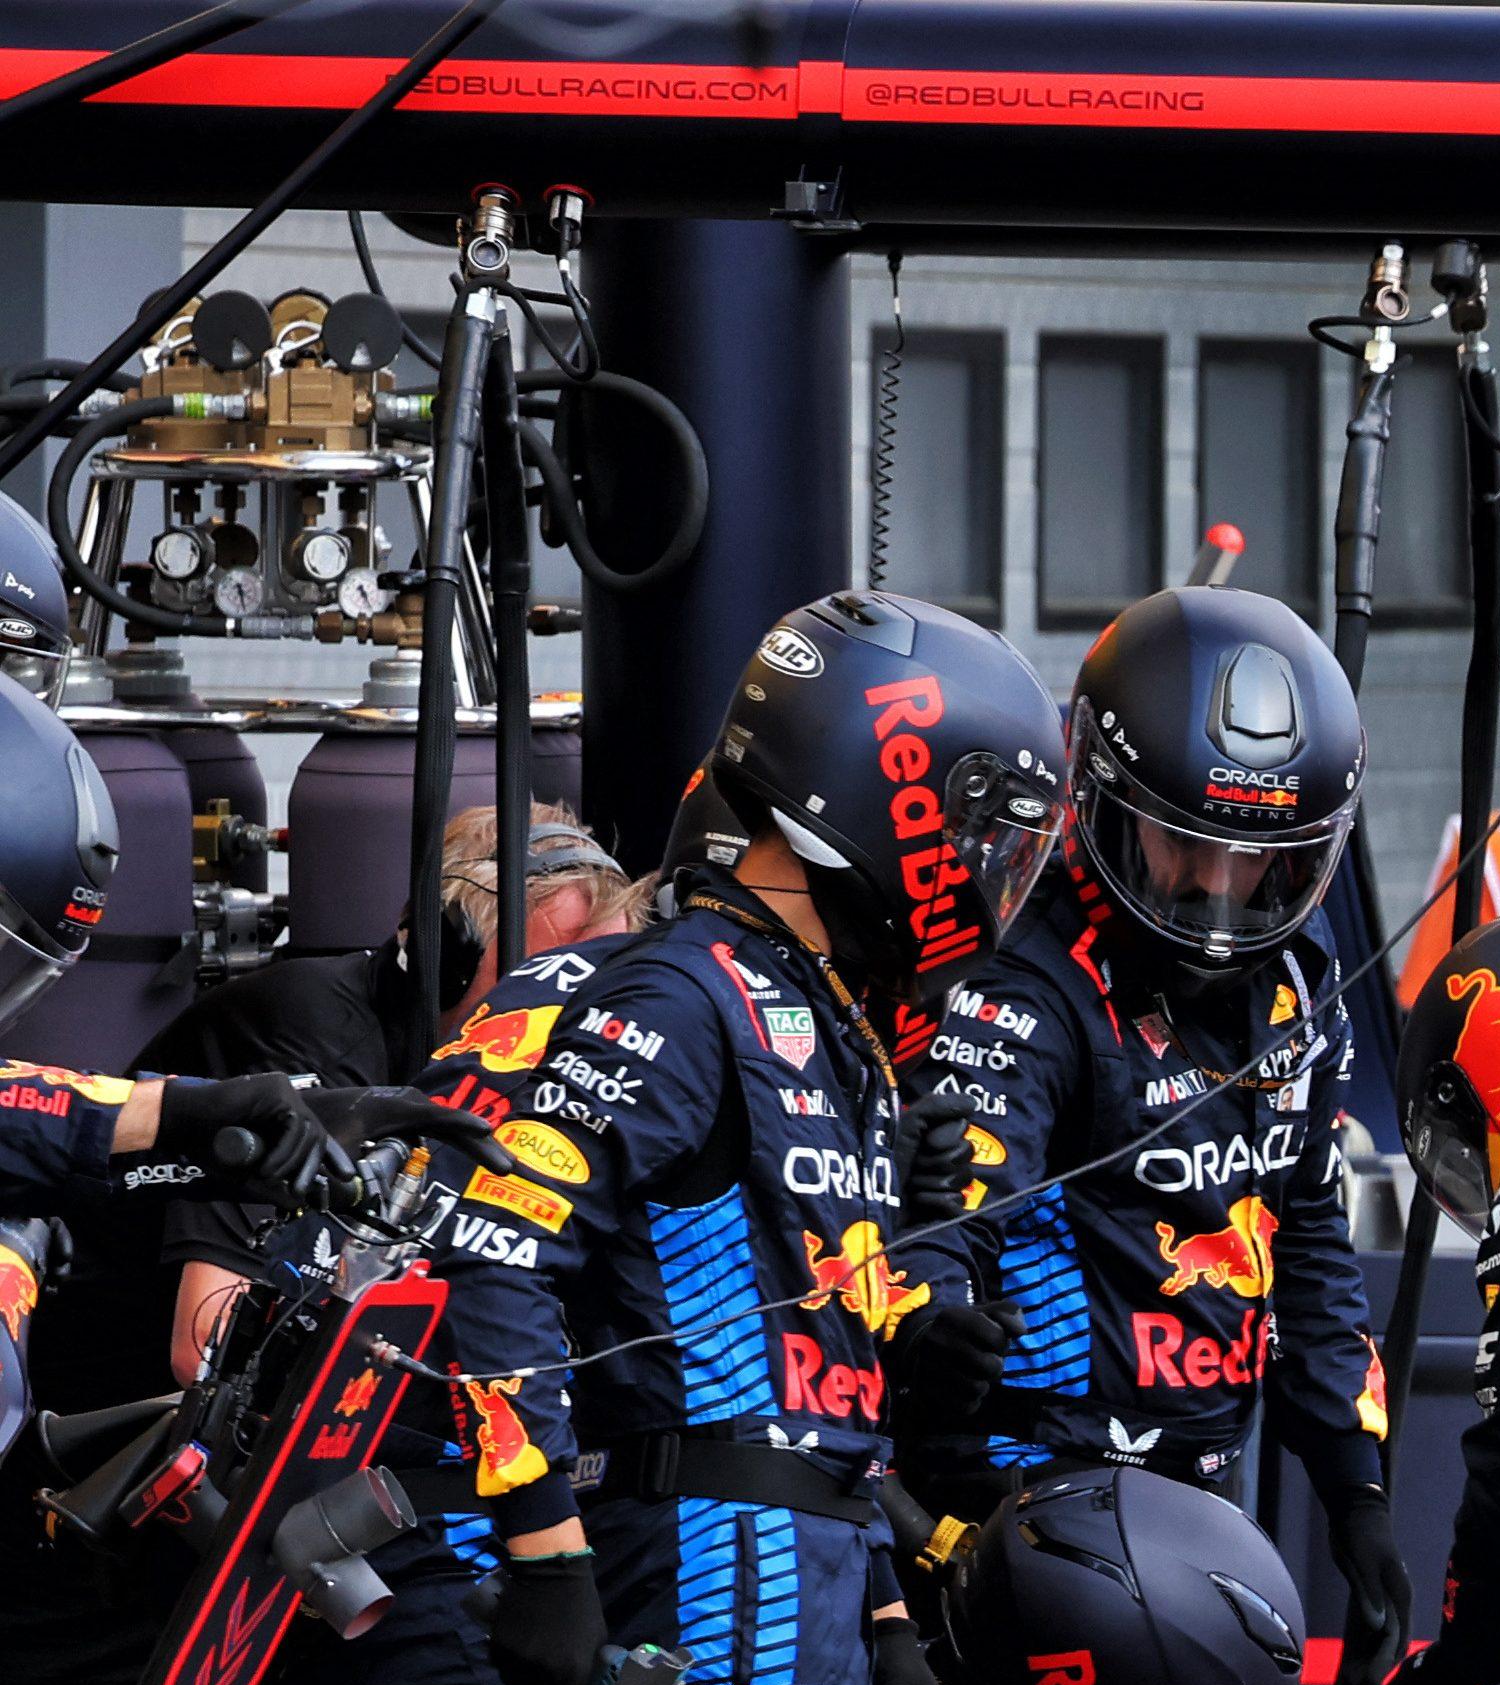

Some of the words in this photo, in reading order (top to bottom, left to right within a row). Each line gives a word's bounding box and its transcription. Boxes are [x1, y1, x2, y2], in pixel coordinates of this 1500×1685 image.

[865, 82, 1205, 112] @REDBULLRACING
[761, 630, 818, 671] HJC
[865, 676, 945, 841] Red
[1209, 767, 1301, 790] ORACLE
[1203, 801, 1297, 820] RACING
[898, 838, 980, 975] Bull
[577, 1007, 665, 1062] Mobil
[768, 1009, 812, 1033] TAG
[951, 990, 1039, 1041] Mobil
[557, 1099, 613, 1136] Sui
[963, 1083, 1006, 1116] Sui
[514, 1130, 578, 1177] RAUCH
[1134, 1124, 1300, 1192] ORACL
[475, 1174, 557, 1222] PIRELLI
[451, 1212, 543, 1269] VISA
[1103, 1451, 1146, 1466] CASTORE
